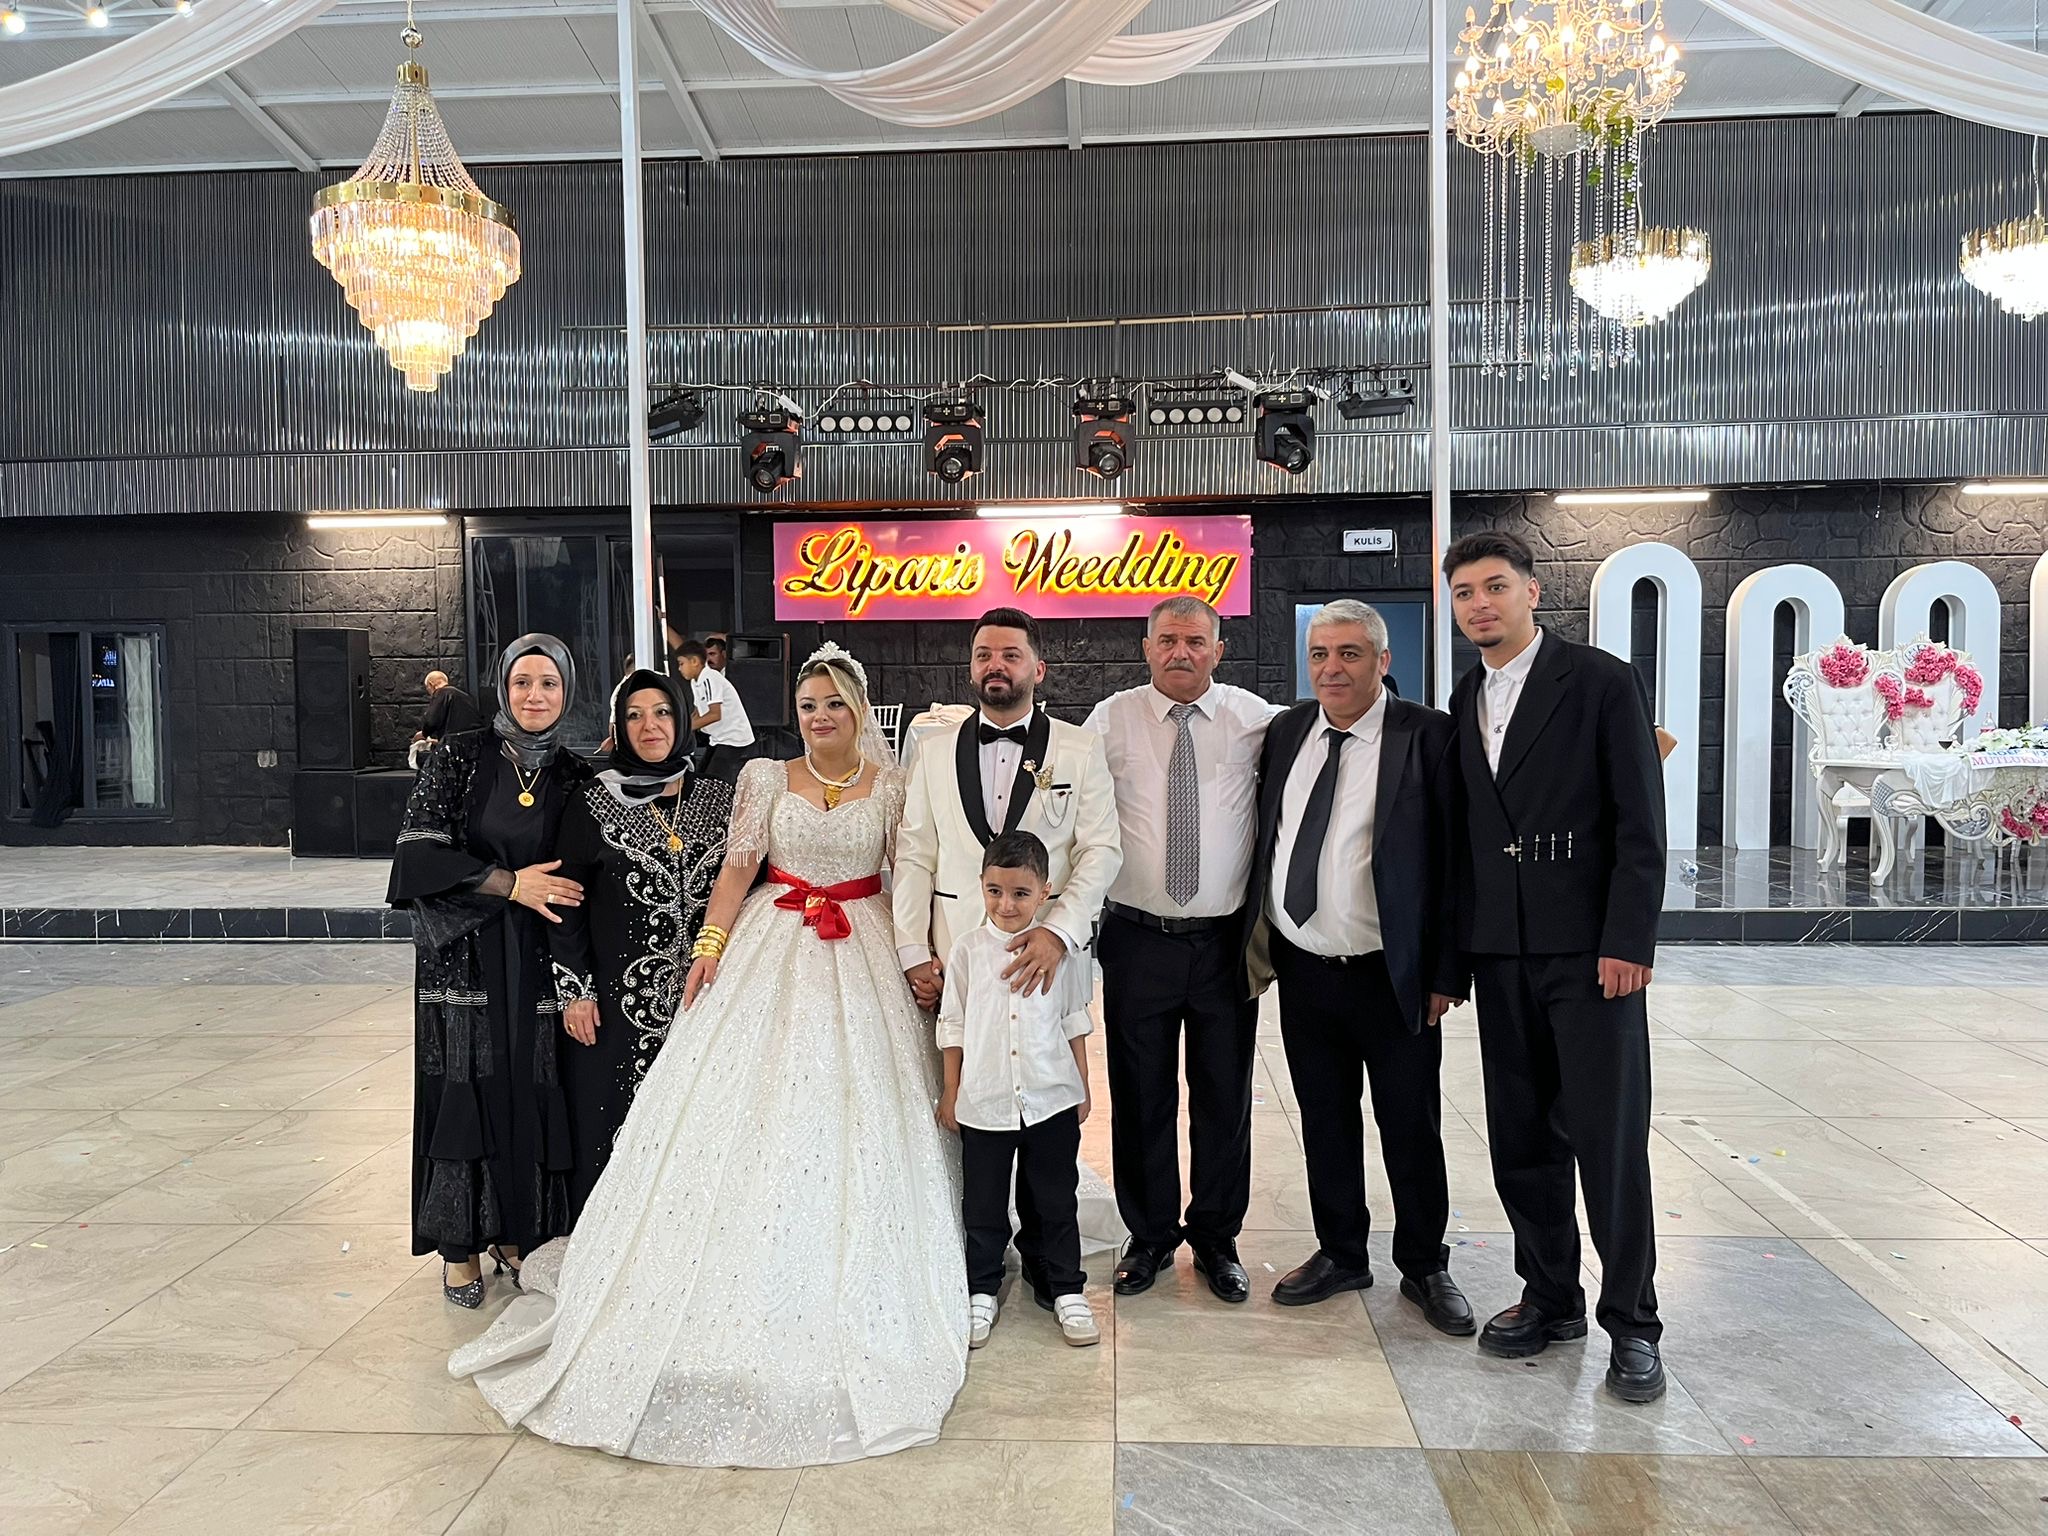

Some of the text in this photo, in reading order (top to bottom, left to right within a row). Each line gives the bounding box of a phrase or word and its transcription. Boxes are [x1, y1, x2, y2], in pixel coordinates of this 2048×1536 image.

[1353, 536, 1382, 546] KULİS
[783, 527, 1240, 615] Liparis Weedding
